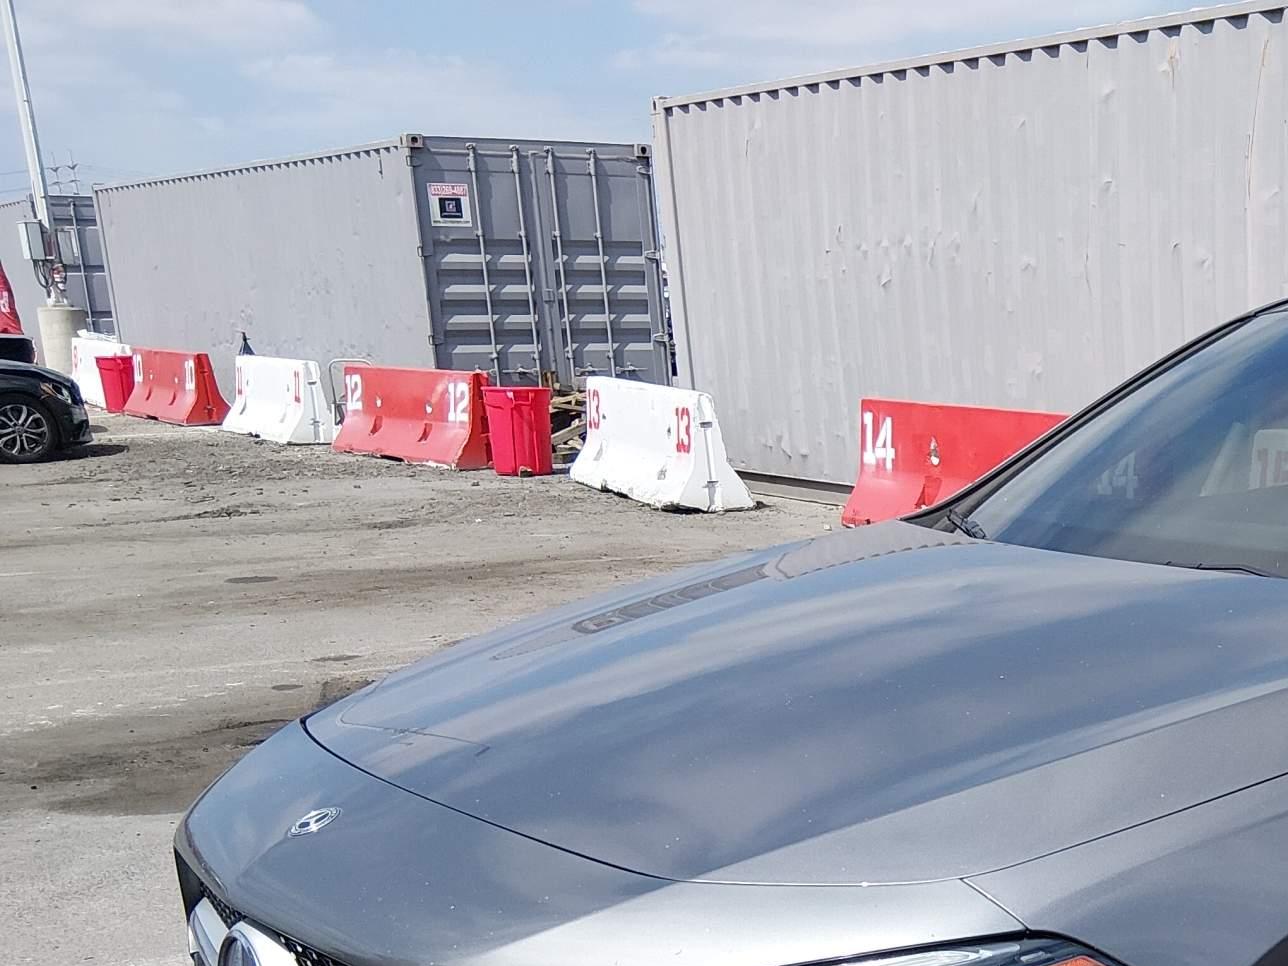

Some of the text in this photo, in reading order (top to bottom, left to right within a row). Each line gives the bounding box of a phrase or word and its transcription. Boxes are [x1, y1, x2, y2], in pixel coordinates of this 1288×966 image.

[132, 352, 144, 383] 10
[184, 359, 196, 391] 10
[293, 370, 301, 403] 11
[345, 374, 363, 411] 12
[447, 382, 470, 423] 12
[588, 389, 600, 430] 13
[675, 407, 692, 454] 13
[863, 411, 896, 472] 14
